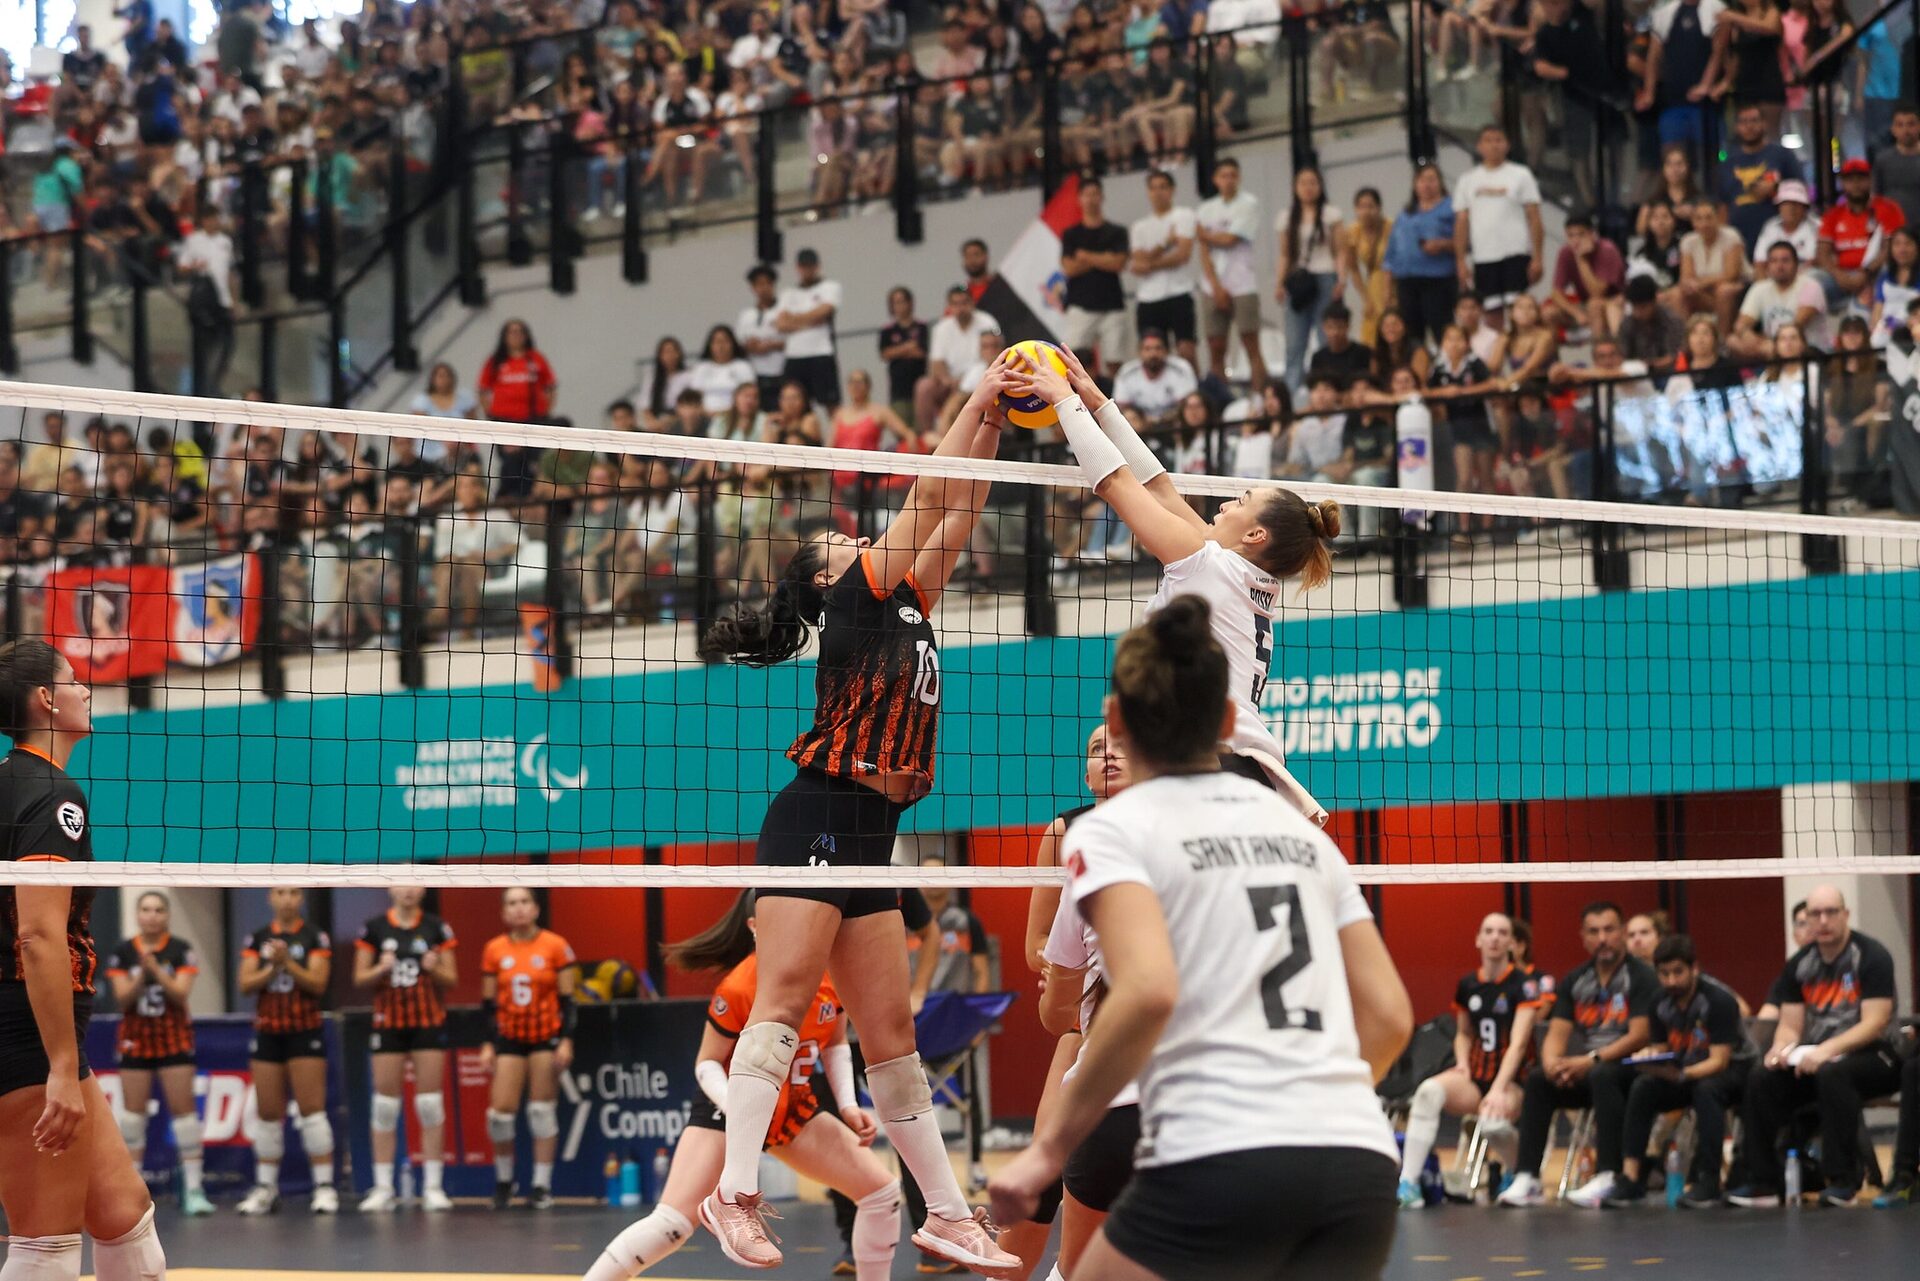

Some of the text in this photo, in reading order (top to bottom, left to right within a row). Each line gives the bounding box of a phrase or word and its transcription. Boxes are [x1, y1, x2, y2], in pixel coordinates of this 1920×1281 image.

[910, 640, 940, 706] 10
[1313, 669, 1401, 705] PUNTO
[1404, 666, 1442, 698] DE
[1246, 884, 1324, 1031] 2
[511, 973, 533, 1006] 6
[1479, 1017, 1497, 1053] 9
[596, 1061, 669, 1100] Chile
